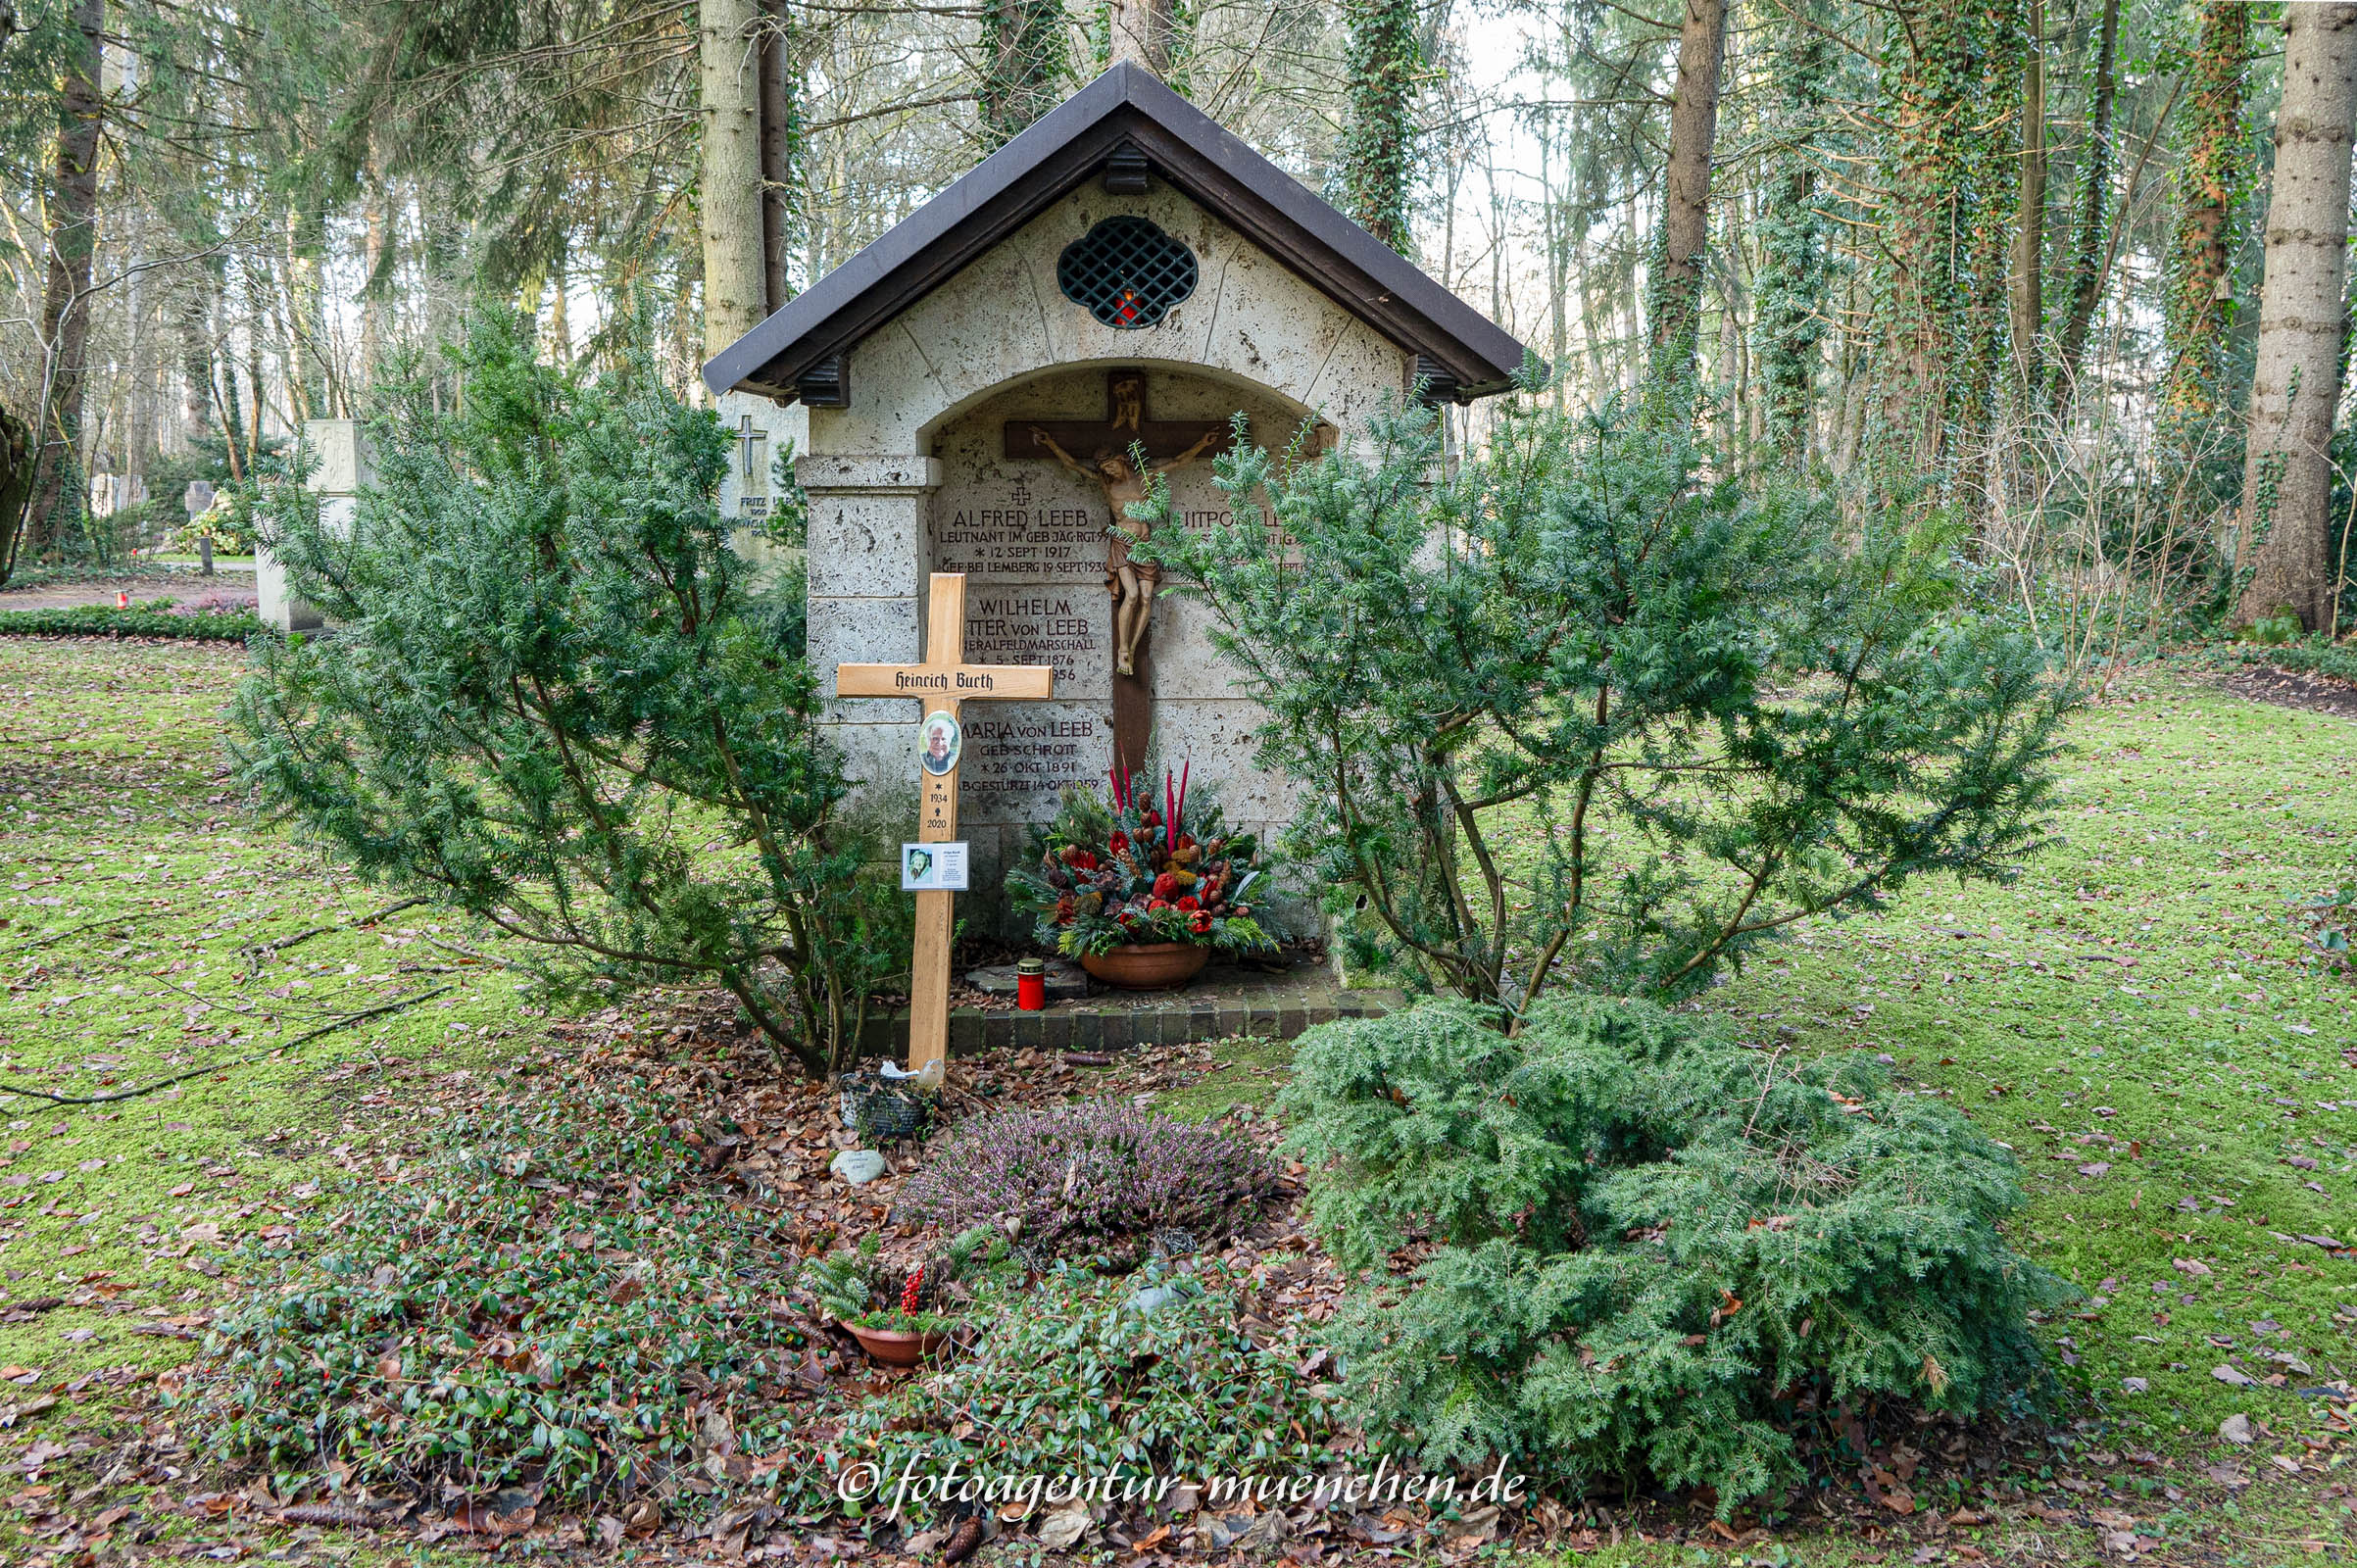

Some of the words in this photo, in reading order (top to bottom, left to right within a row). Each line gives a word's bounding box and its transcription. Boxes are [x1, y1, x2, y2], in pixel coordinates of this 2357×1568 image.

[741, 497, 766, 506] FRITZ
[954, 510, 1028, 527] ALFRED
[1039, 510, 1088, 526] LEEB
[940, 531, 1006, 543] LEUTNANT
[1008, 531, 1022, 543] IM
[1045, 546, 1071, 558] 1917
[987, 562, 1040, 573] LEMBERG
[980, 599, 1072, 615] WILHELM
[1047, 619, 1089, 636] LEEB
[895, 670, 949, 691] Heinrich
[956, 671, 994, 692] Burth
[1051, 721, 1094, 737] LEEB
[1012, 744, 1078, 757] SCHROTT
[1046, 761, 1075, 773] 1891
[930, 794, 948, 804] 1934
[927, 819, 947, 829] 2020
